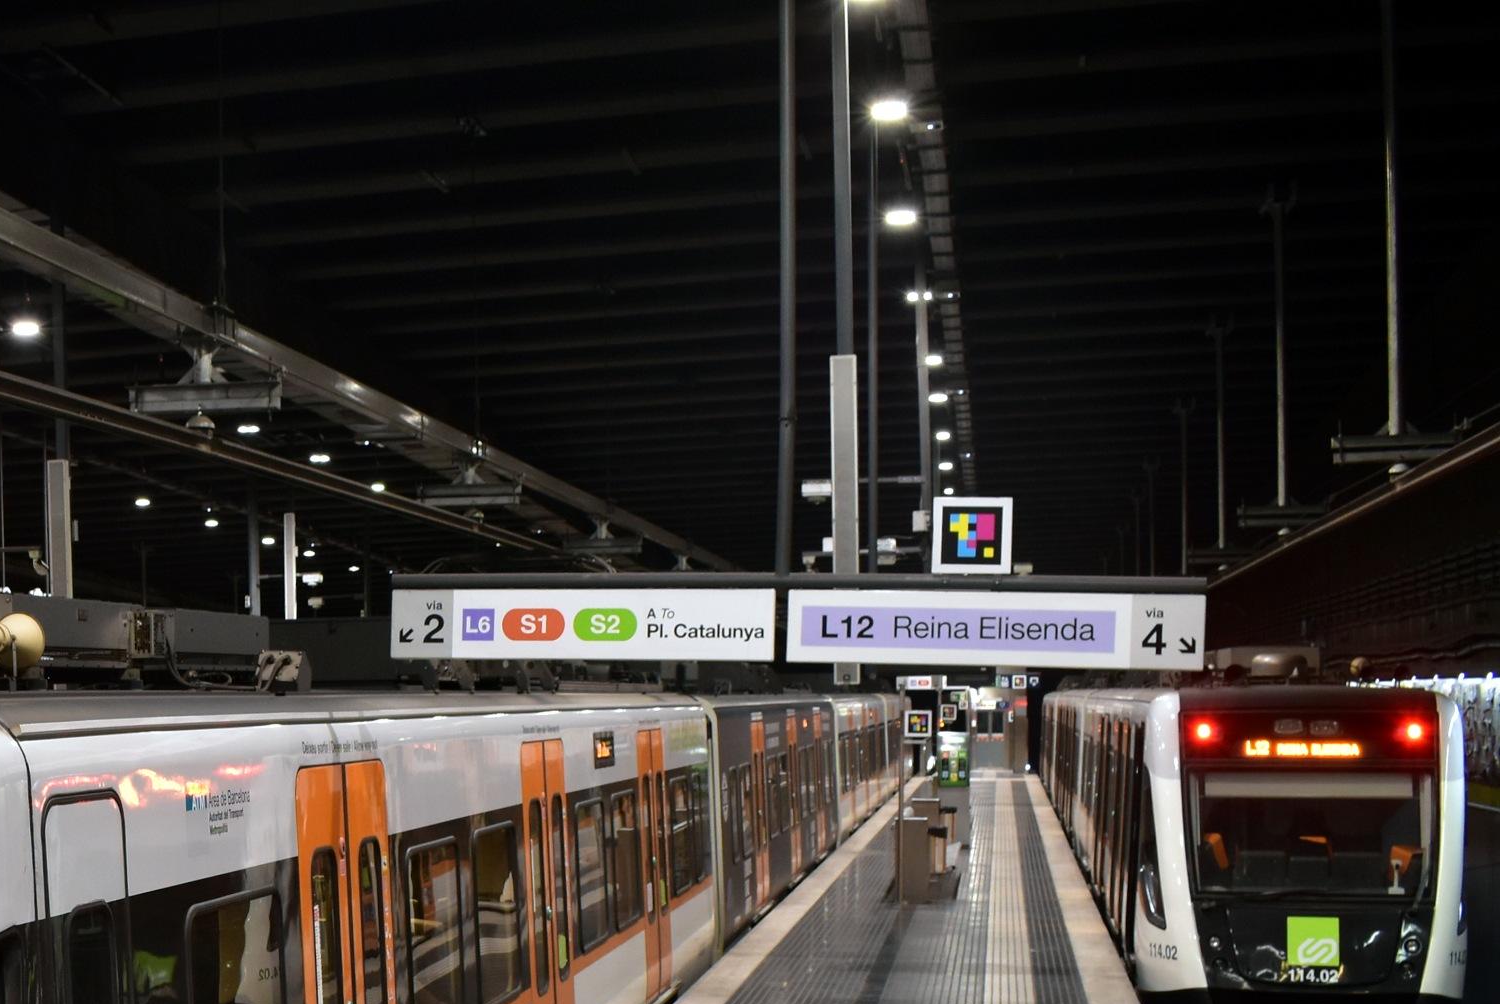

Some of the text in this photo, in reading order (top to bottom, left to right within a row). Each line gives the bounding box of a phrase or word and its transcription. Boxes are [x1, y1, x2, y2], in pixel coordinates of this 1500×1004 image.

[426, 601, 443, 611] via
[646, 608, 675, 620] A To
[1145, 607, 1165, 619] via
[423, 614, 445, 643] 2
[465, 614, 621, 634] L6 S1 S2
[647, 622, 765, 642] Pl. Catalunya
[820, 614, 1097, 642] L12 Reina Elisenda
[1140, 622, 1167, 655] 4
[1149, 943, 1179, 961] 114.02
[1287, 967, 1340, 984] 114.02
